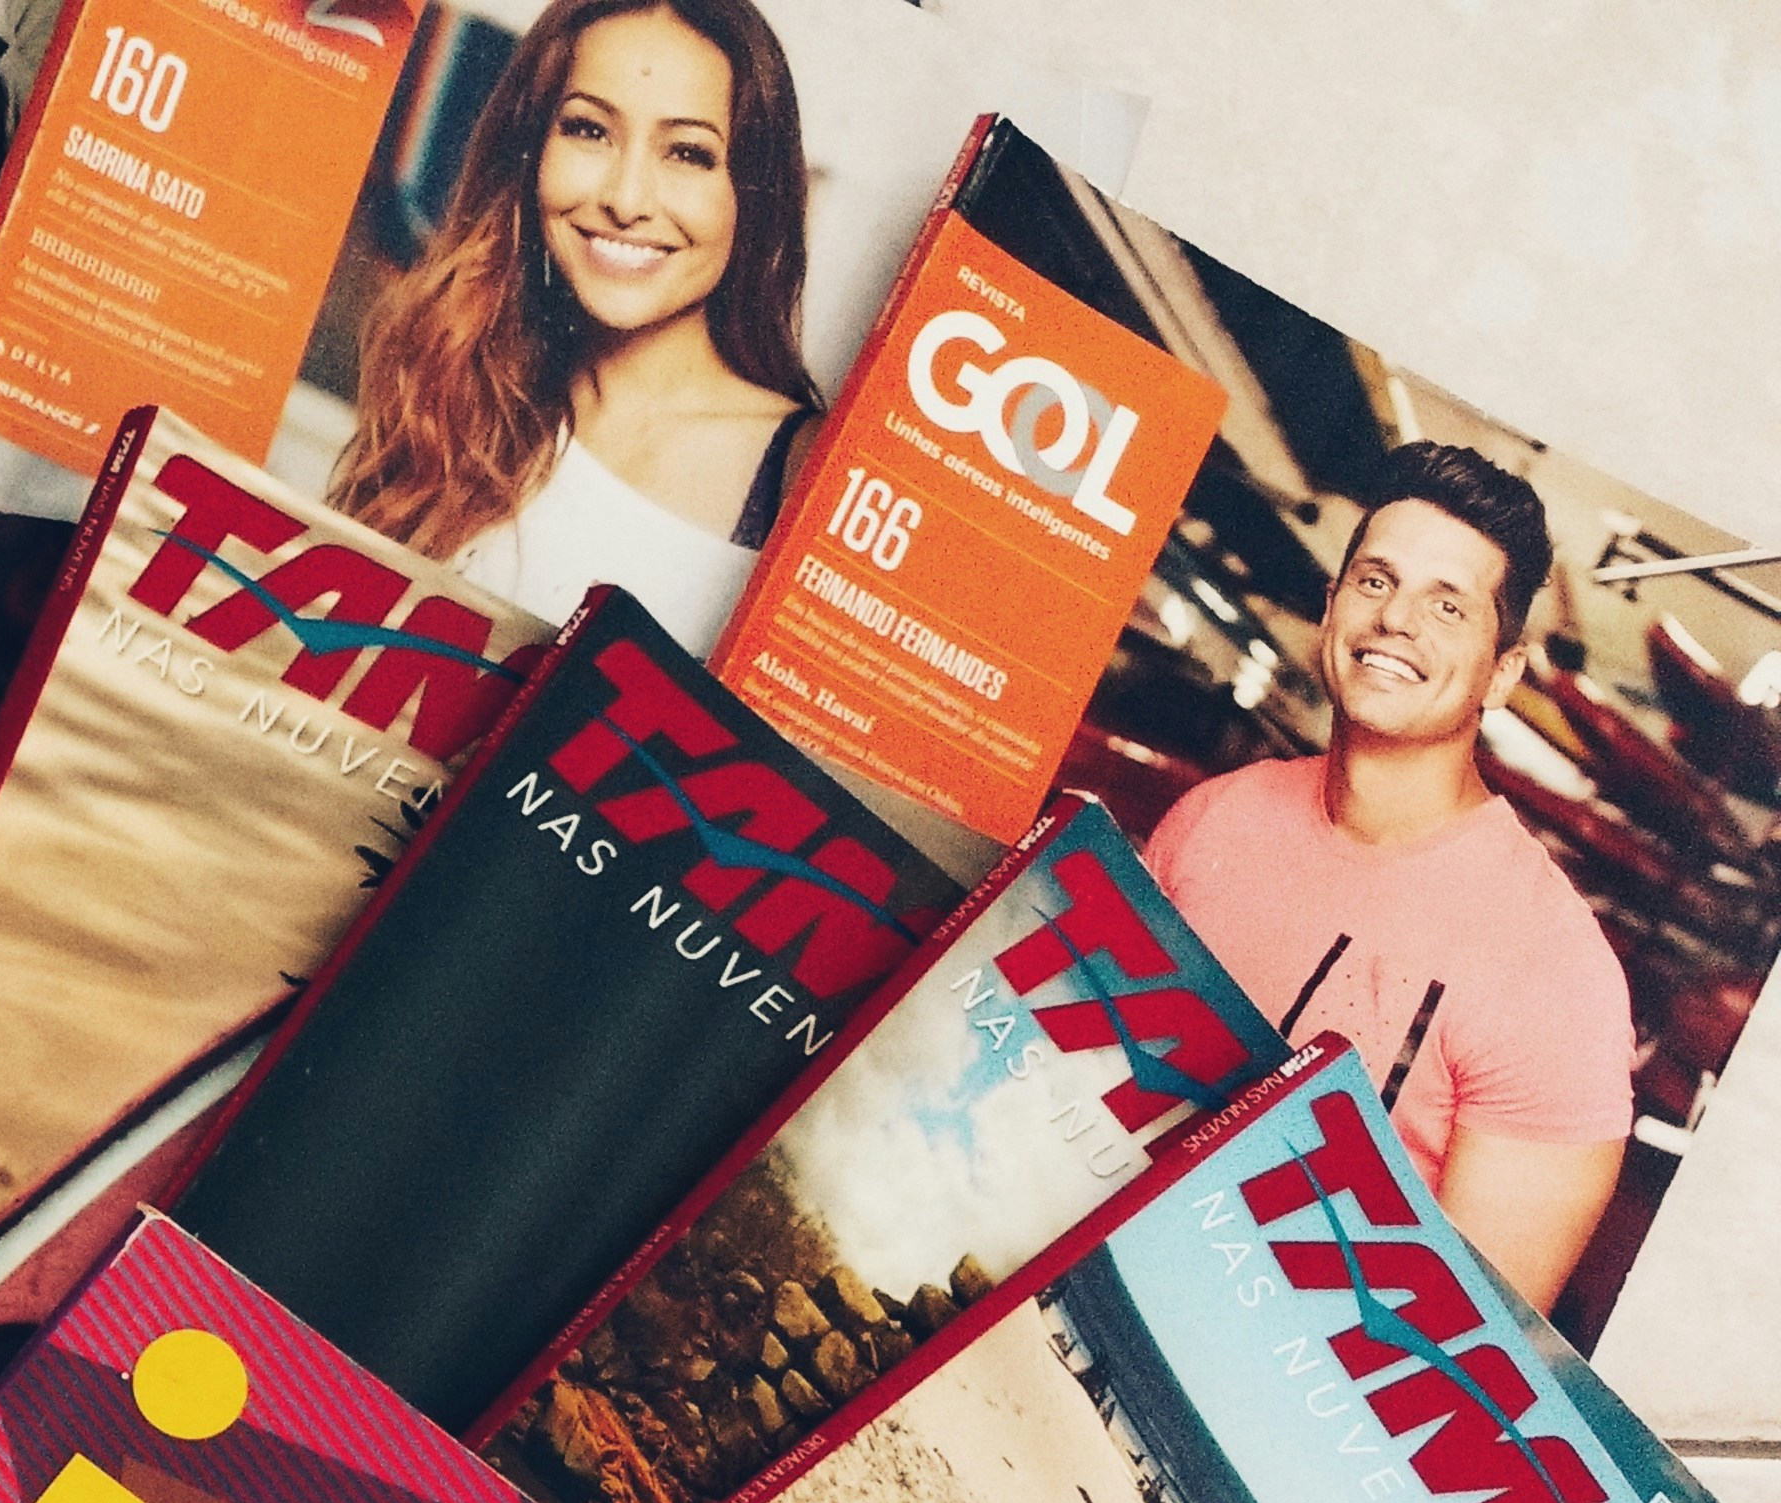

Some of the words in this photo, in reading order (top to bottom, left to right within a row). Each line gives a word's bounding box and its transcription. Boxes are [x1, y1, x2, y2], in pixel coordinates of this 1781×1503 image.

[90, 26, 188, 133] 160
[64, 125, 149, 196] SABRINA
[150, 168, 206, 219] SATO
[957, 265, 1026, 322] REVISTA
[908, 311, 1140, 536] GOL
[826, 466, 923, 572] 166
[884, 411, 941, 459] Linhas
[943, 452, 1003, 497] aéreas
[1005, 489, 1111, 561] inteligentes
[96, 609, 216, 697] NAS
[794, 553, 892, 637] FERNANDO
[891, 615, 1009, 702] FERNANDES
[506, 772, 618, 876] NAS
[950, 969, 1042, 1082] NAS
[1191, 1189, 1275, 1309] NAS
